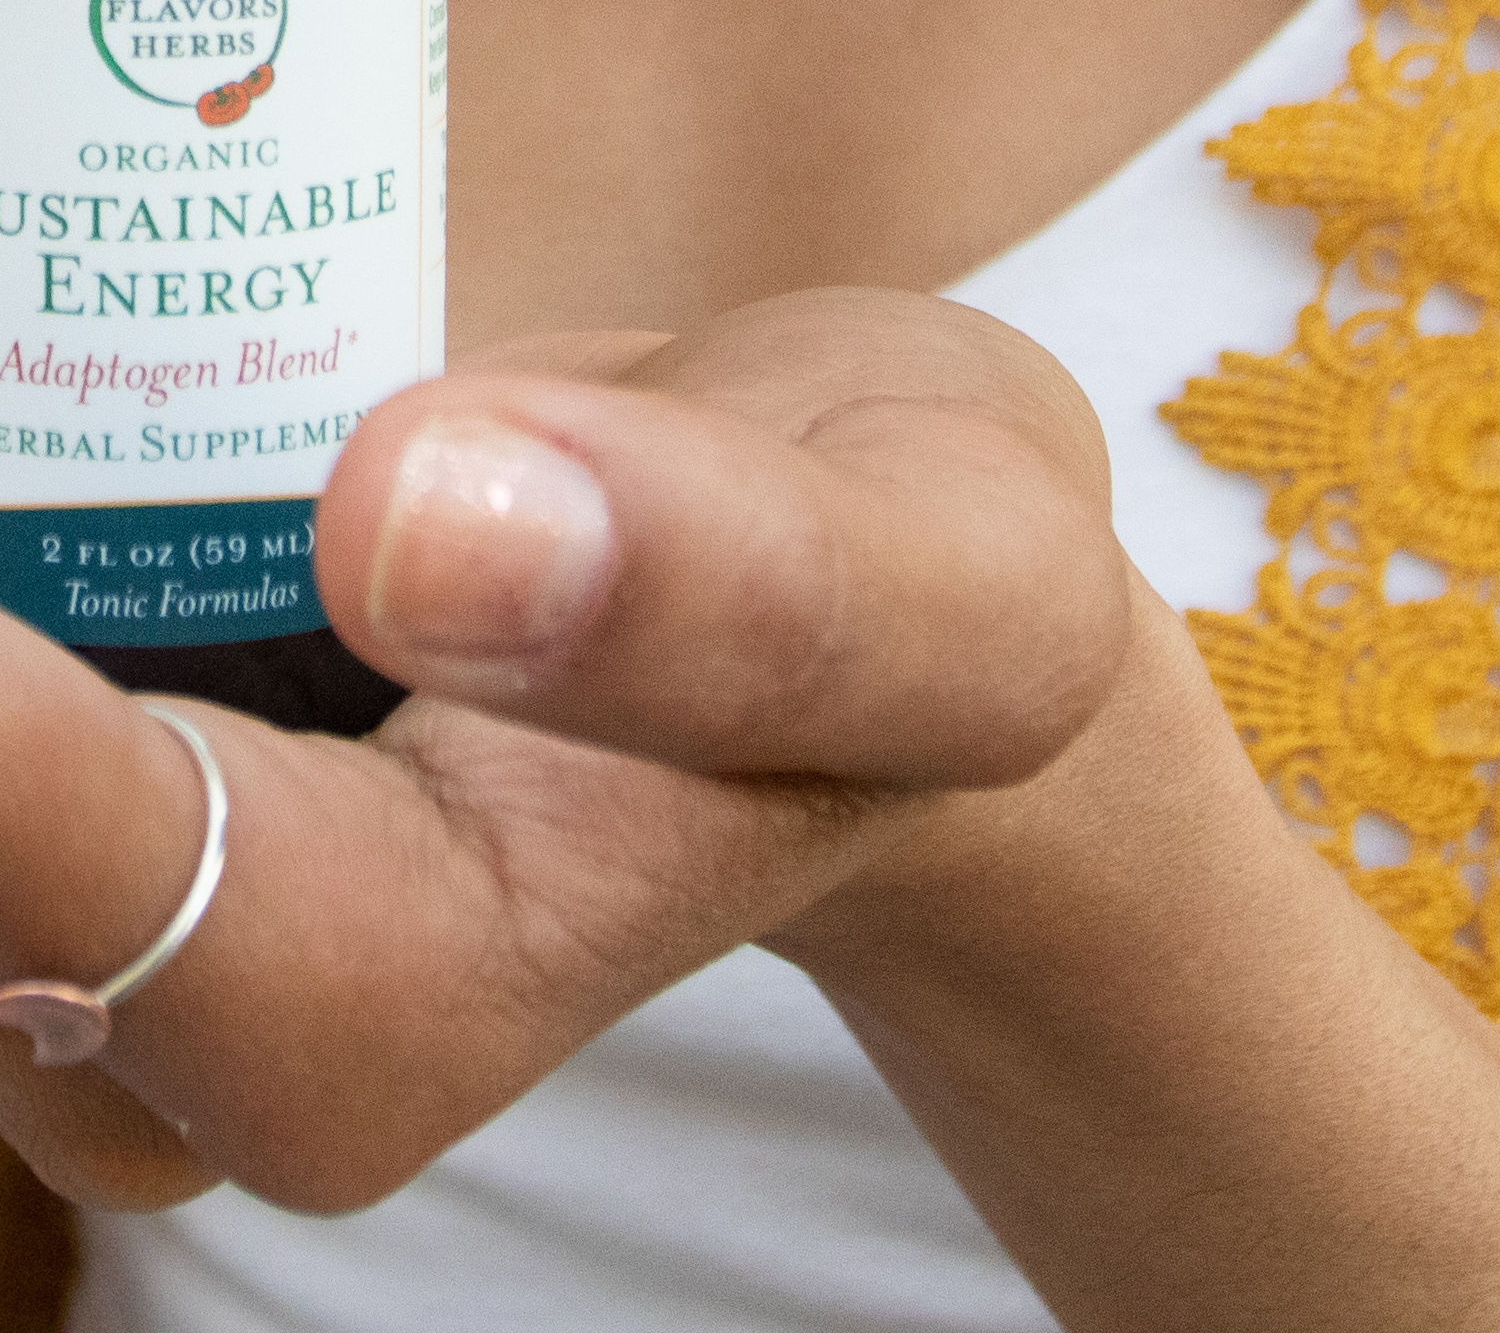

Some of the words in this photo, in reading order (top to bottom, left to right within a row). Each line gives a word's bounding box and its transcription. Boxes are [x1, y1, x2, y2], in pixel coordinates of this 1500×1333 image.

[130, 32, 256, 59] HERBS
[78, 138, 280, 173] ORGANIC
[35, 251, 331, 318] ENERGY
[42, 535, 62, 564] 2
[78, 542, 118, 567] FL
[129, 542, 175, 567] OZ
[189, 534, 247, 570] (59
[261, 521, 315, 559] ML)
[65, 580, 148, 618] Tonic
[158, 571, 300, 619] Formulas
